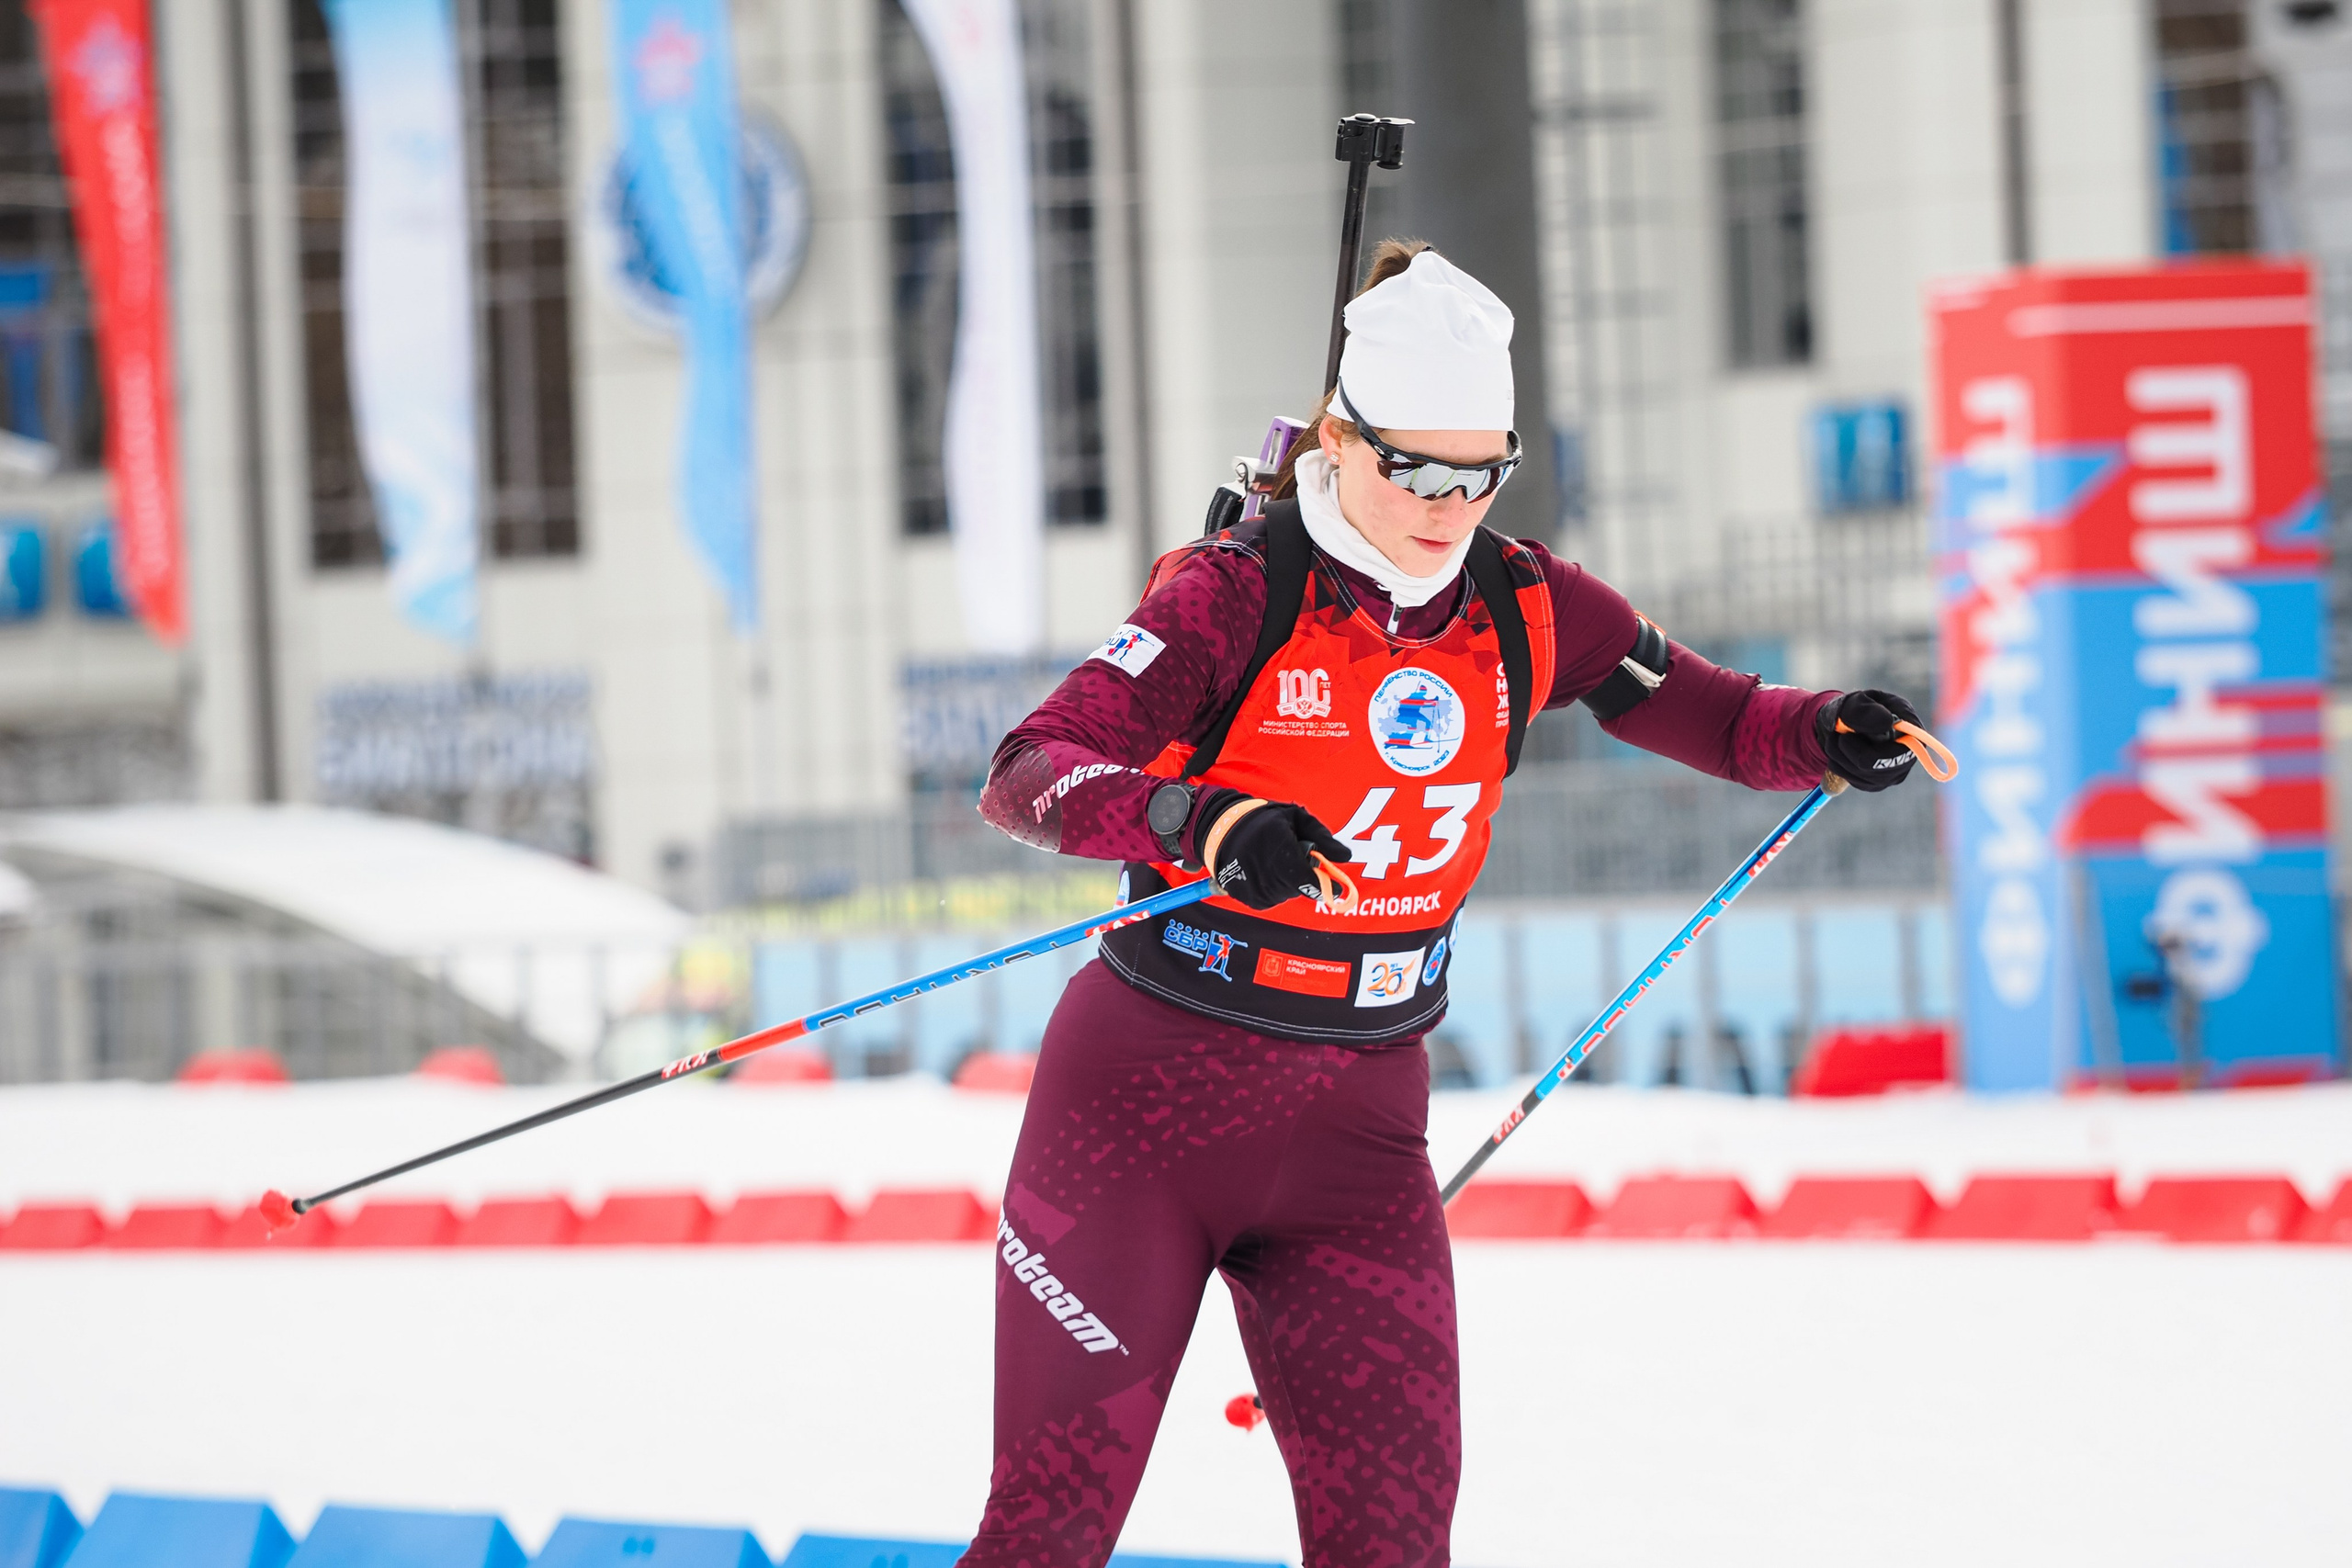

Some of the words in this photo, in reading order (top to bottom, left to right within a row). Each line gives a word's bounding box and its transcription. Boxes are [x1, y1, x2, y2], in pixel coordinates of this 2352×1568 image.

[1277, 668, 1331, 705] 100
[1419, 671, 1453, 698] РОССИИ
[1962, 375, 2052, 1008] ФИНИШ
[2124, 364, 2269, 1001] ФИНИШ
[1258, 727, 1305, 737] РОССИЙСКОЙ
[1306, 729, 1350, 738] ФЕДЕРАЦИИ
[1262, 720, 1319, 728] МИНИСТЕРСТВО
[1032, 763, 1146, 824] protea
[1332, 780, 1482, 881] 43
[1163, 925, 1208, 951] СБР
[1285, 966, 1306, 976] КРАЙ
[1287, 959, 1346, 974] КРАСНОЯРСКИЙ
